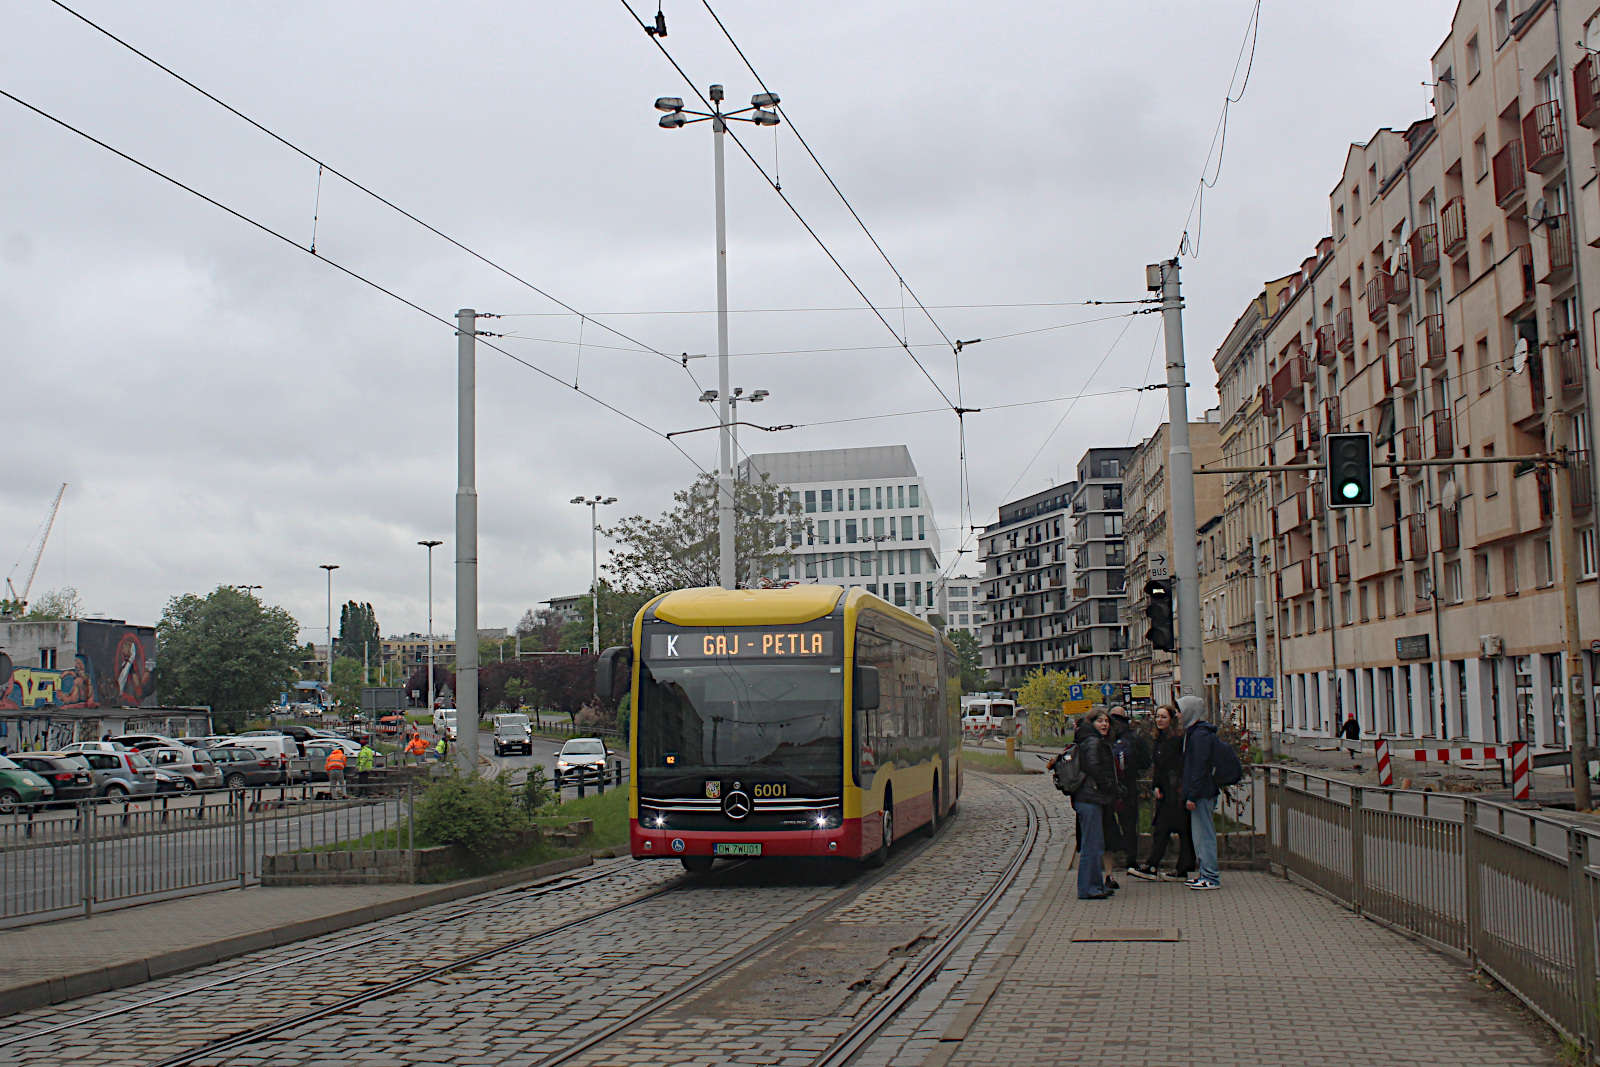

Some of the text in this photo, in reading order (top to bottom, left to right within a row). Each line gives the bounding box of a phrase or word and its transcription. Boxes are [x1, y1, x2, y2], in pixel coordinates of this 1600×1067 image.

[1151, 567, 1167, 576] BUS
[667, 635, 679, 657] K
[703, 635, 739, 655] GAJ
[1072, 686, 1080, 697] P
[754, 784, 787, 797] 6001
